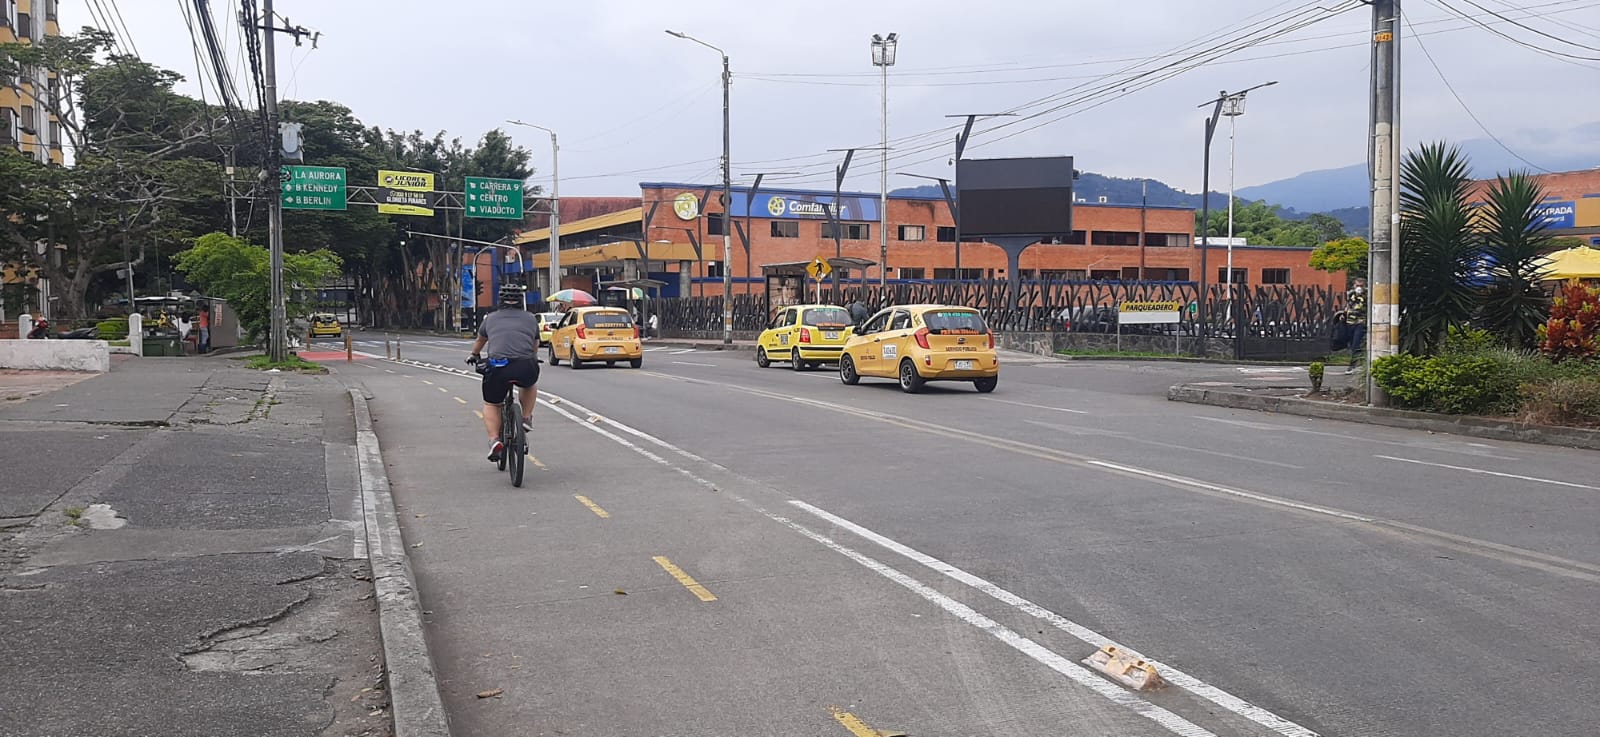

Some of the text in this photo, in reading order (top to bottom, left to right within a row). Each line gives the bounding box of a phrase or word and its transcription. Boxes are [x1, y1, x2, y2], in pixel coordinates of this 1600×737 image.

[295, 171, 341, 181] LA AURORA
[480, 182, 512, 191] CARRERA
[480, 194, 509, 203] CENTRO
[480, 206, 516, 215] VIADUCTO
